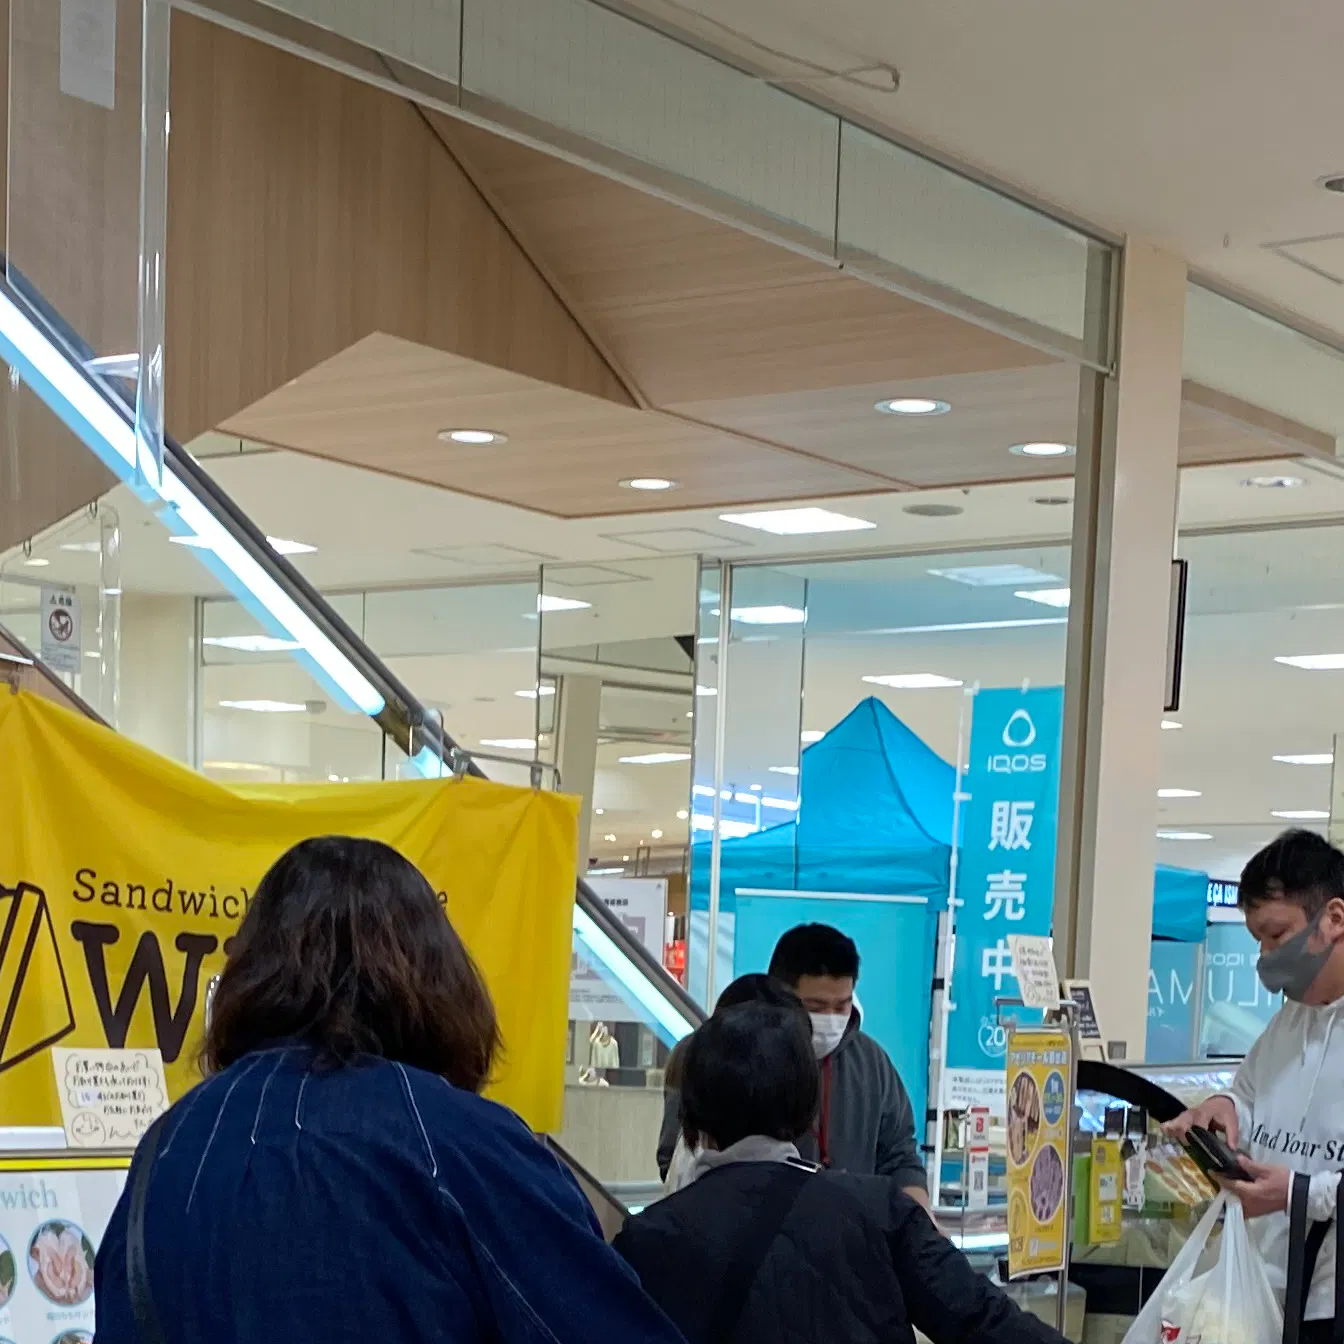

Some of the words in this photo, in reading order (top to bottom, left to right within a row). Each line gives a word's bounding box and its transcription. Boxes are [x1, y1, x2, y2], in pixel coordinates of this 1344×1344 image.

[987, 754, 1047, 774] IQOS
[981, 800, 1036, 991] 販売中
[1282, 1132, 1320, 1157] Your
